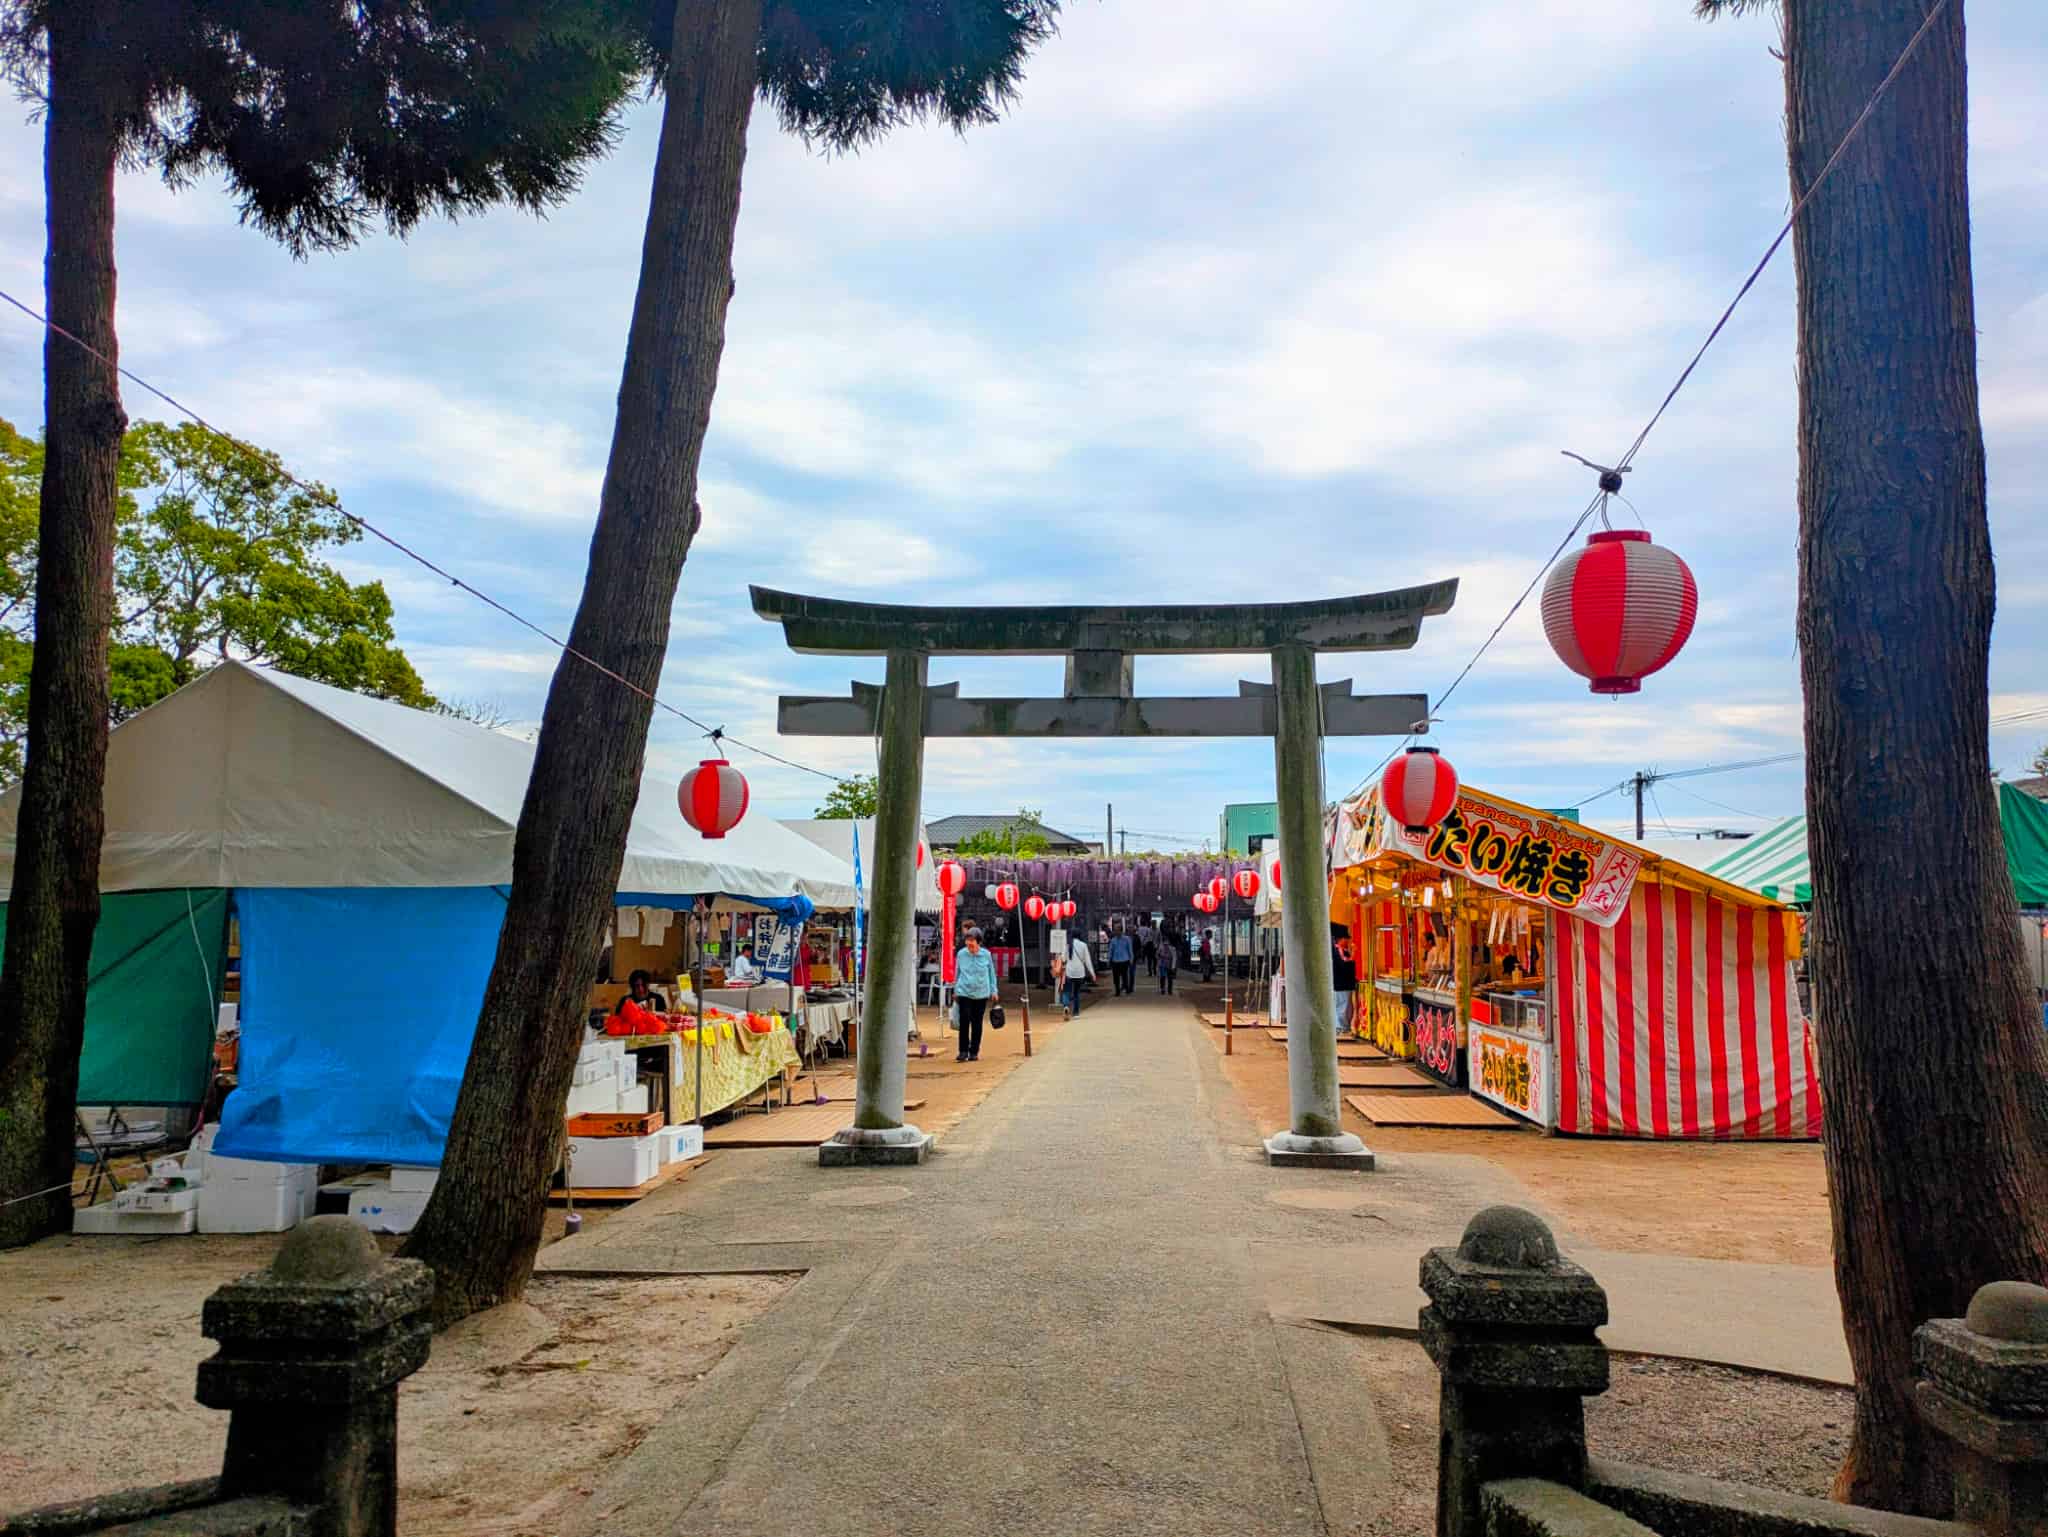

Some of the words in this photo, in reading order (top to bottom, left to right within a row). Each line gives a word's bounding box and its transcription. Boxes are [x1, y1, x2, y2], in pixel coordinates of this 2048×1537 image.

[1428, 807, 1593, 906] たい焼き
[1456, 799, 1532, 831] apanese
[1537, 820, 1605, 857] Taiyaki
[1594, 856, 1629, 911] 大人気
